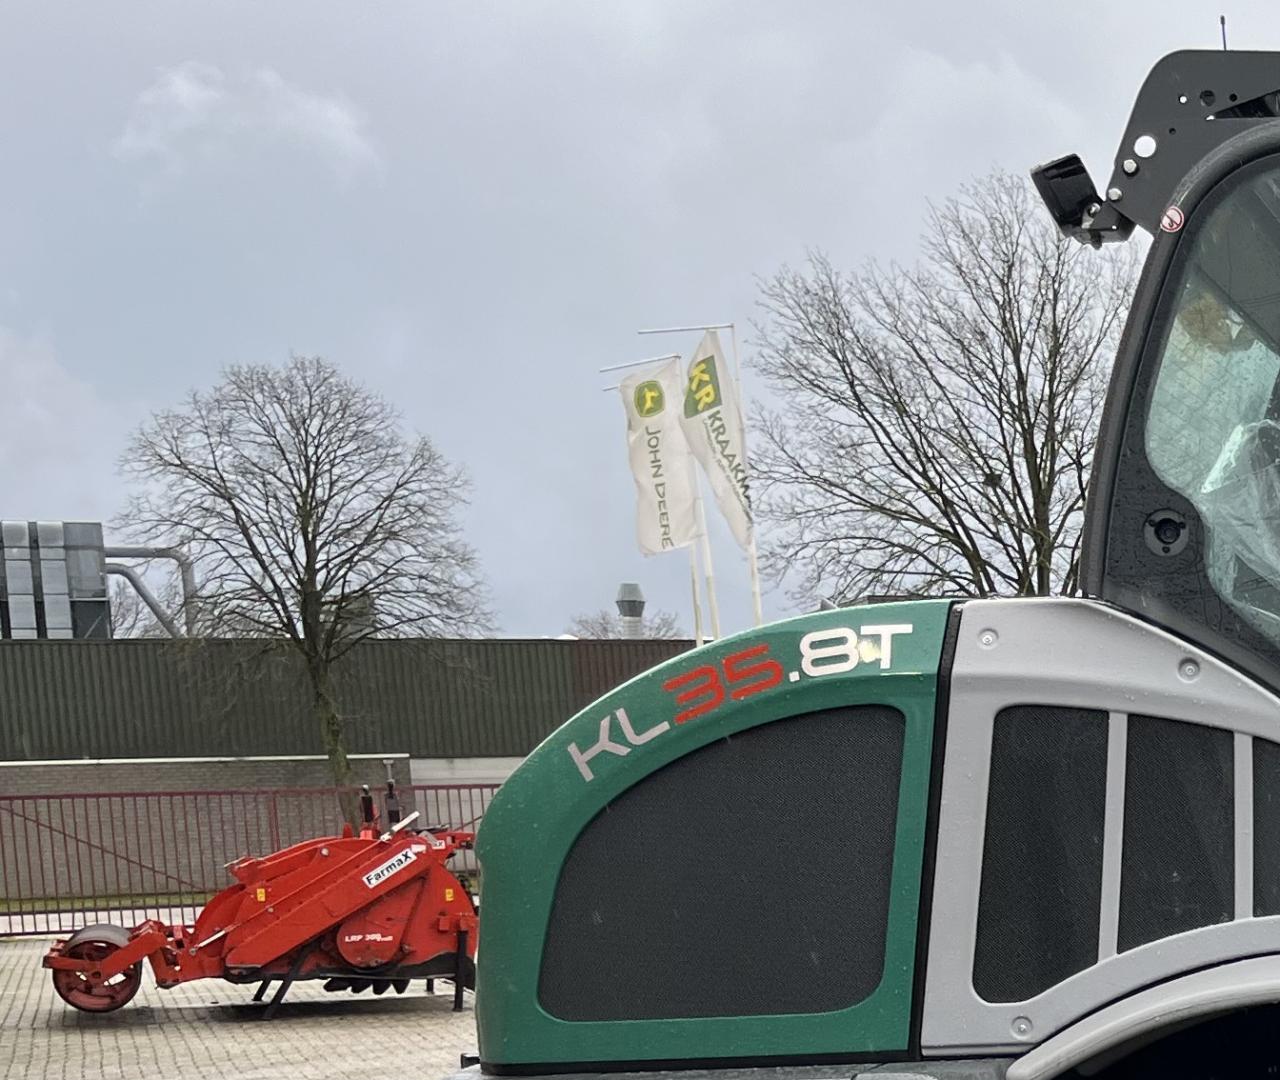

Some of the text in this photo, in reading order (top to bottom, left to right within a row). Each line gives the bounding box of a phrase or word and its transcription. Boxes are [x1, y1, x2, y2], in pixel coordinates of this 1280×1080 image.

[691, 363, 715, 411] KR
[645, 426, 674, 550] JOHN DEERE
[707, 410, 753, 513] KRAAKM
